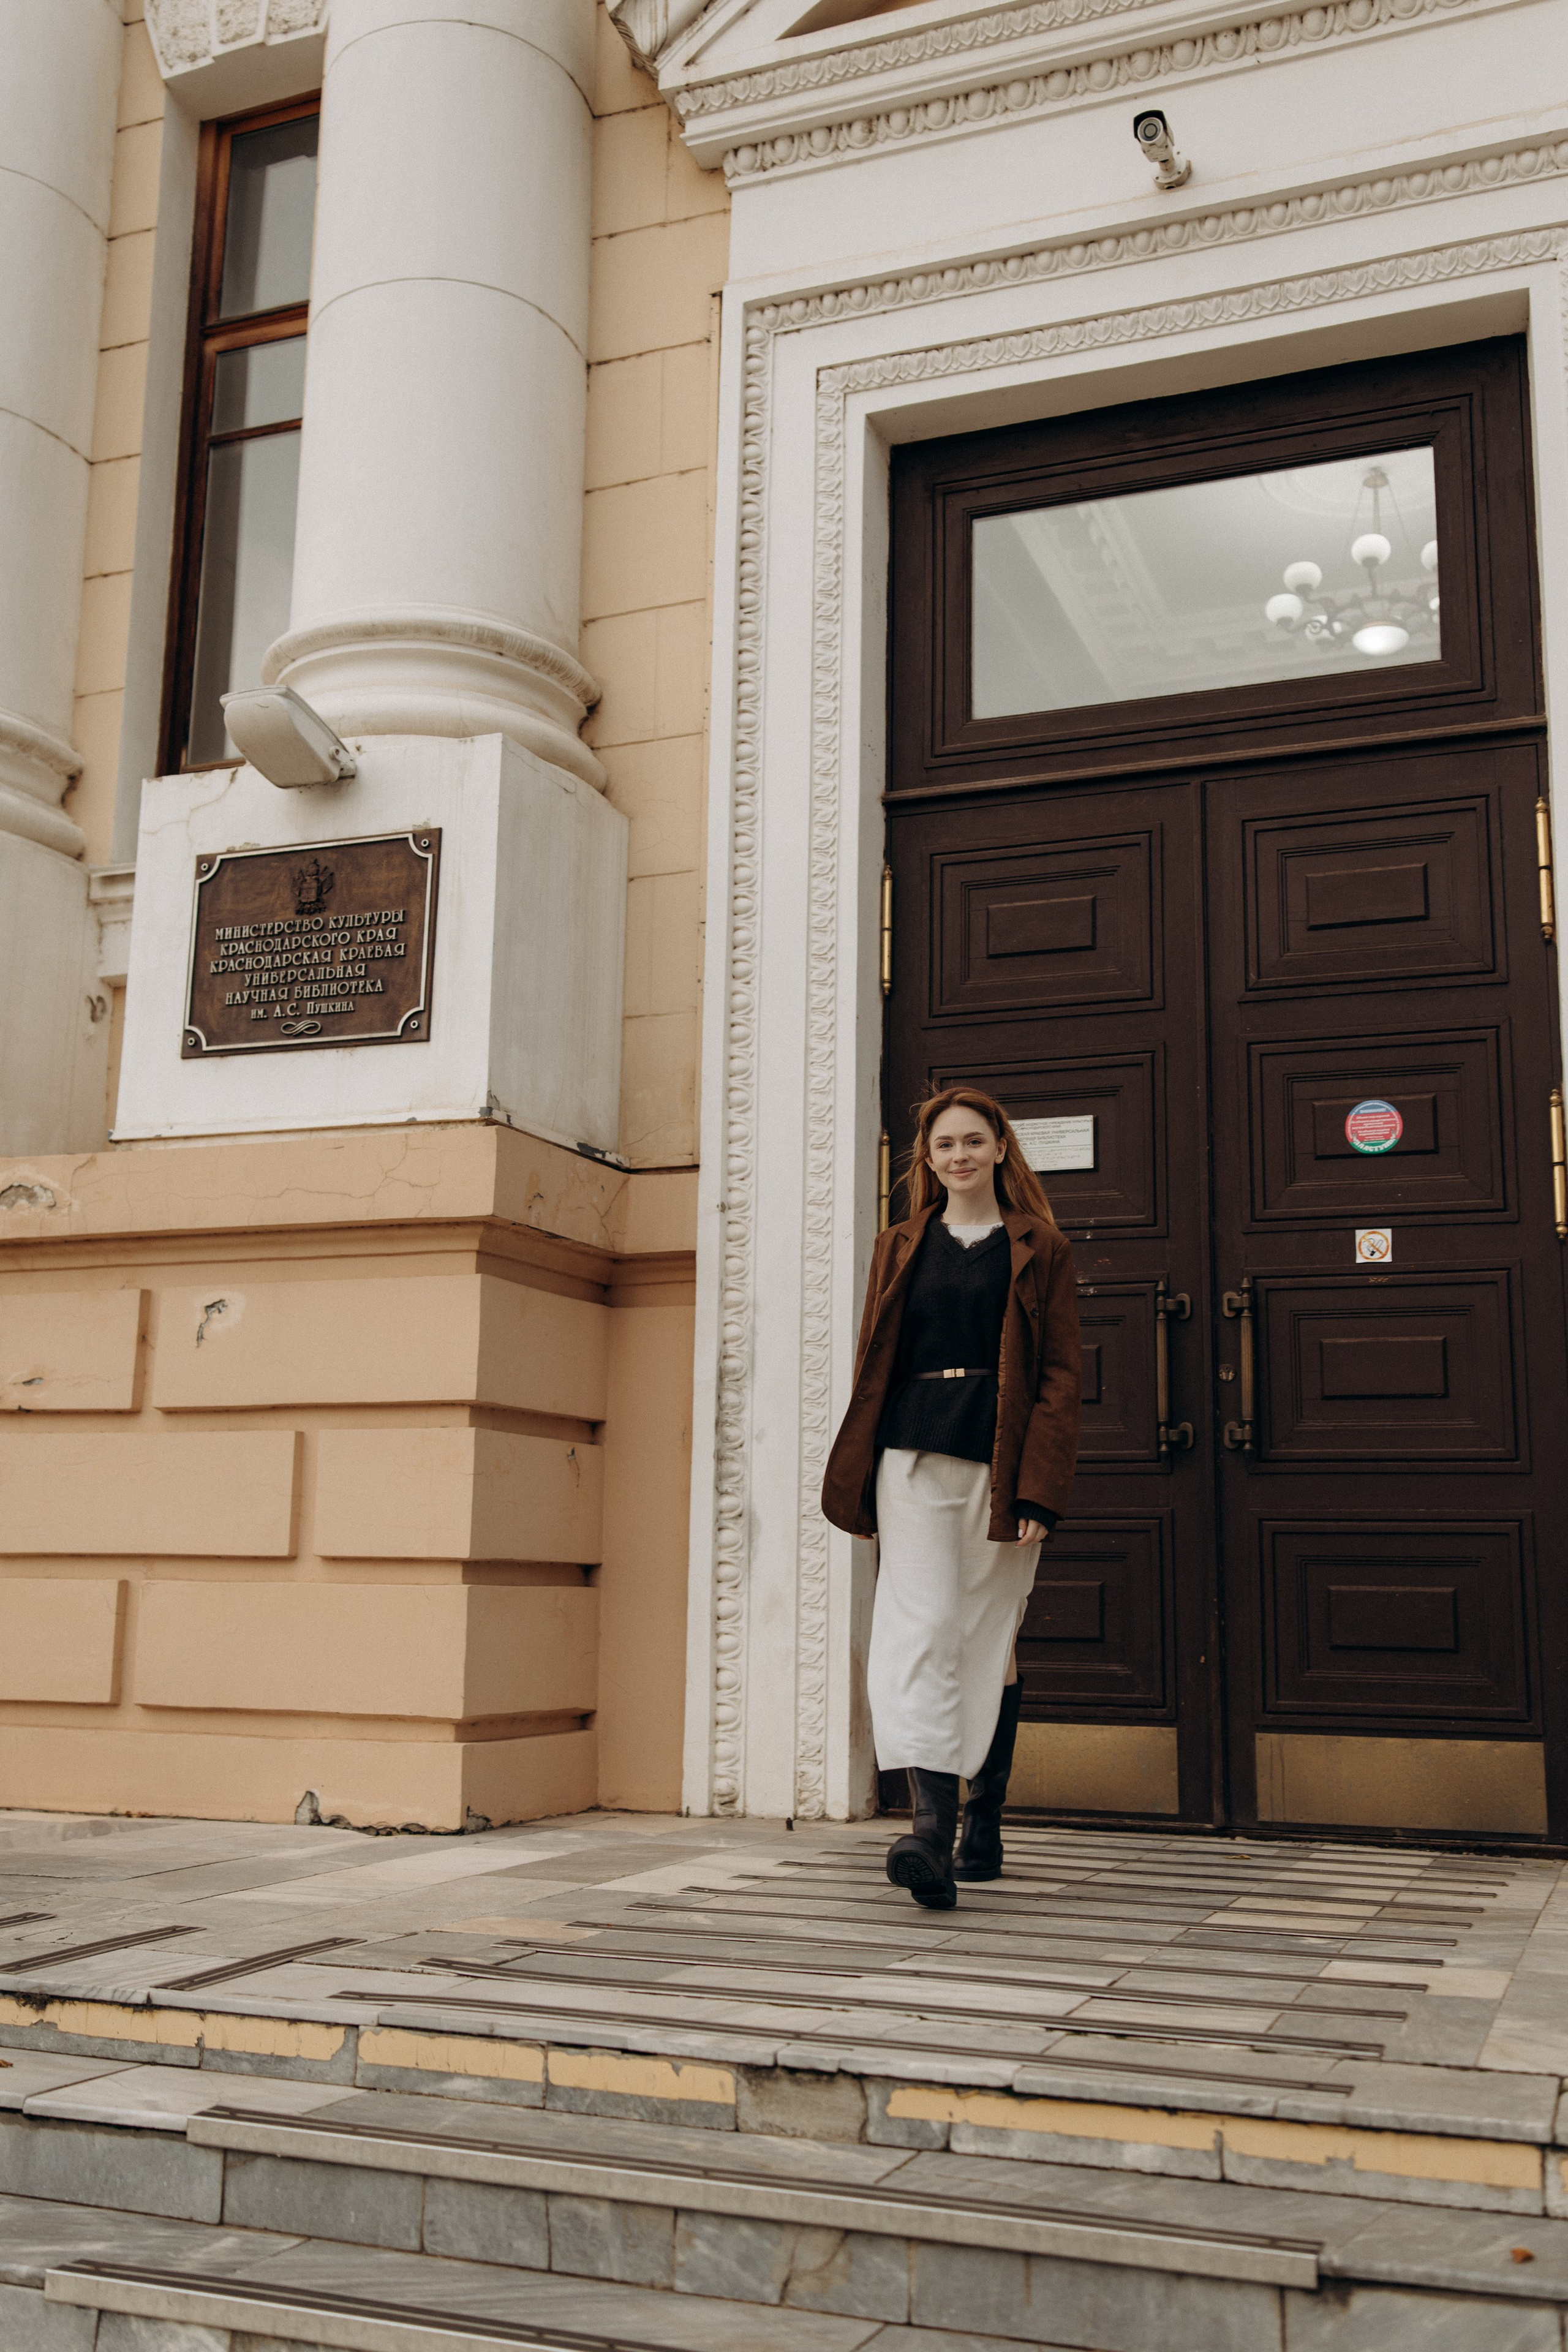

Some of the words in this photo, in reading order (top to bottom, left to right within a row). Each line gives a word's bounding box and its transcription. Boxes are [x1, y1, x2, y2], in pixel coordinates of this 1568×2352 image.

[215, 917, 323, 941] МИНИСТЕРСТВО
[328, 909, 405, 929] КУЛЬТУРЫ
[220, 932, 350, 956] КРАСНОДАРСКОГО
[356, 927, 398, 943] КРАЯ
[209, 950, 333, 973] КРАСНОДАРСКАЯ
[339, 943, 405, 961] КРАЕВАЯ
[244, 963, 366, 987] УНИВЕРСАЛЬНАЯ
[225, 987, 288, 1005] НАУЧНАЯ
[294, 978, 383, 999] БИБЛИОТЕКА
